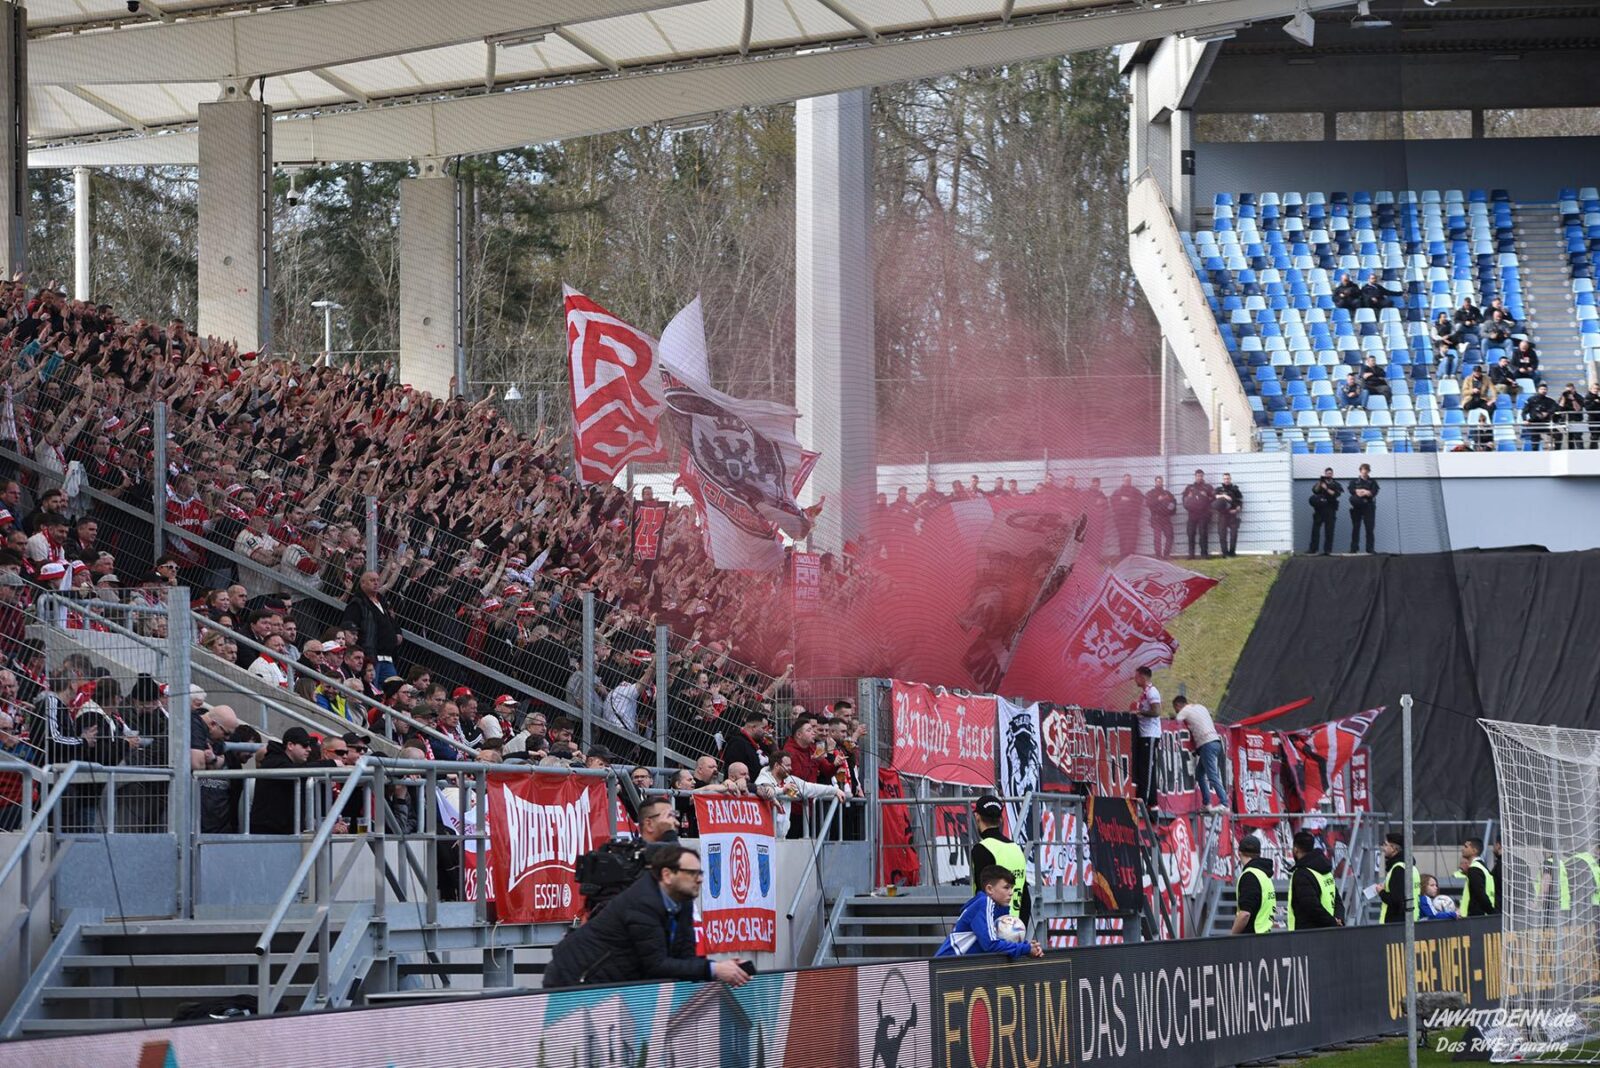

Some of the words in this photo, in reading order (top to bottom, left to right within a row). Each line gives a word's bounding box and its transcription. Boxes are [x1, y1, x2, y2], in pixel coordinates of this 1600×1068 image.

[706, 800, 763, 826] FANCLUB
[535, 884, 562, 909] ESSEN
[1079, 973, 1127, 1062] DAS
[1133, 956, 1311, 1052] WOCHENMAGAZIN
[1386, 938, 1438, 1021] UNERE
[943, 980, 1071, 1068] FORUM
